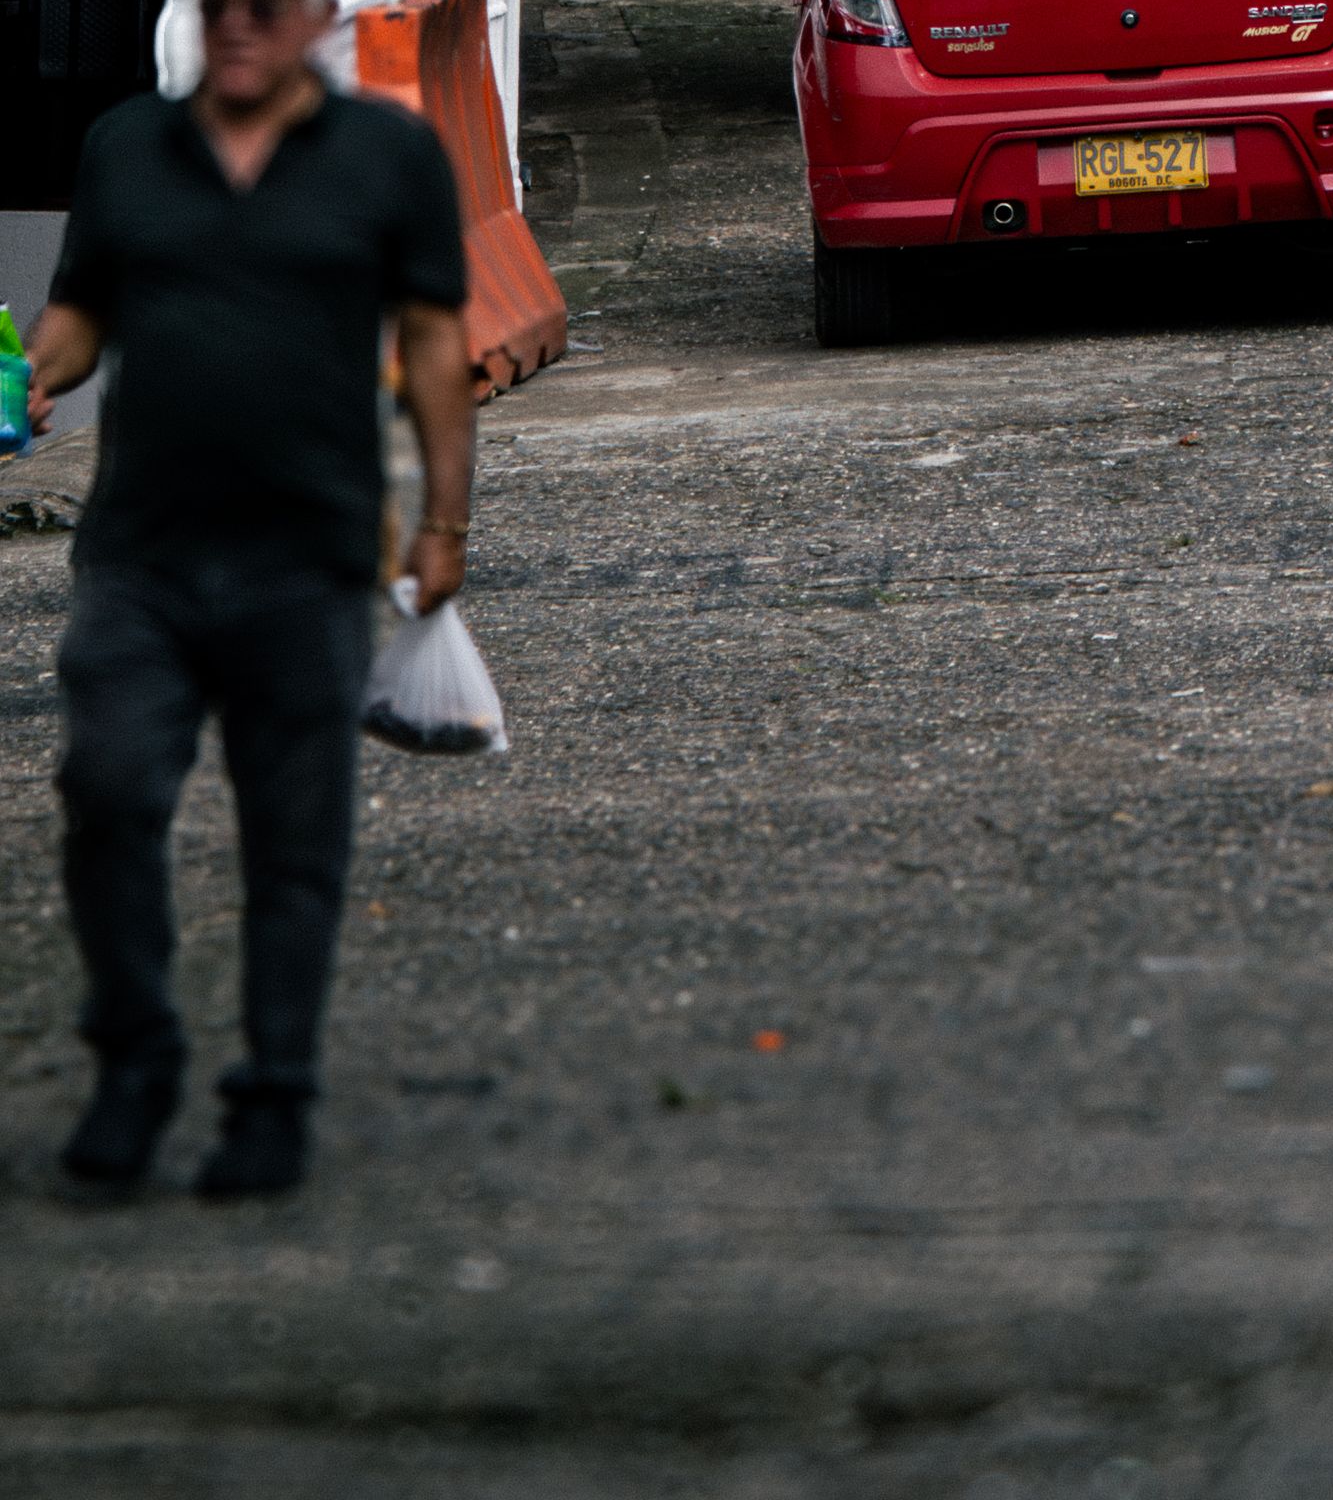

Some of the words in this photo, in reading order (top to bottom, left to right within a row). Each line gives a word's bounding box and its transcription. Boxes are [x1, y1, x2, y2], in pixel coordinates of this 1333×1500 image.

[1247, 3, 1329, 19] SANDERO
[929, 23, 1010, 40] RENAULT
[1290, 23, 1318, 43] GT
